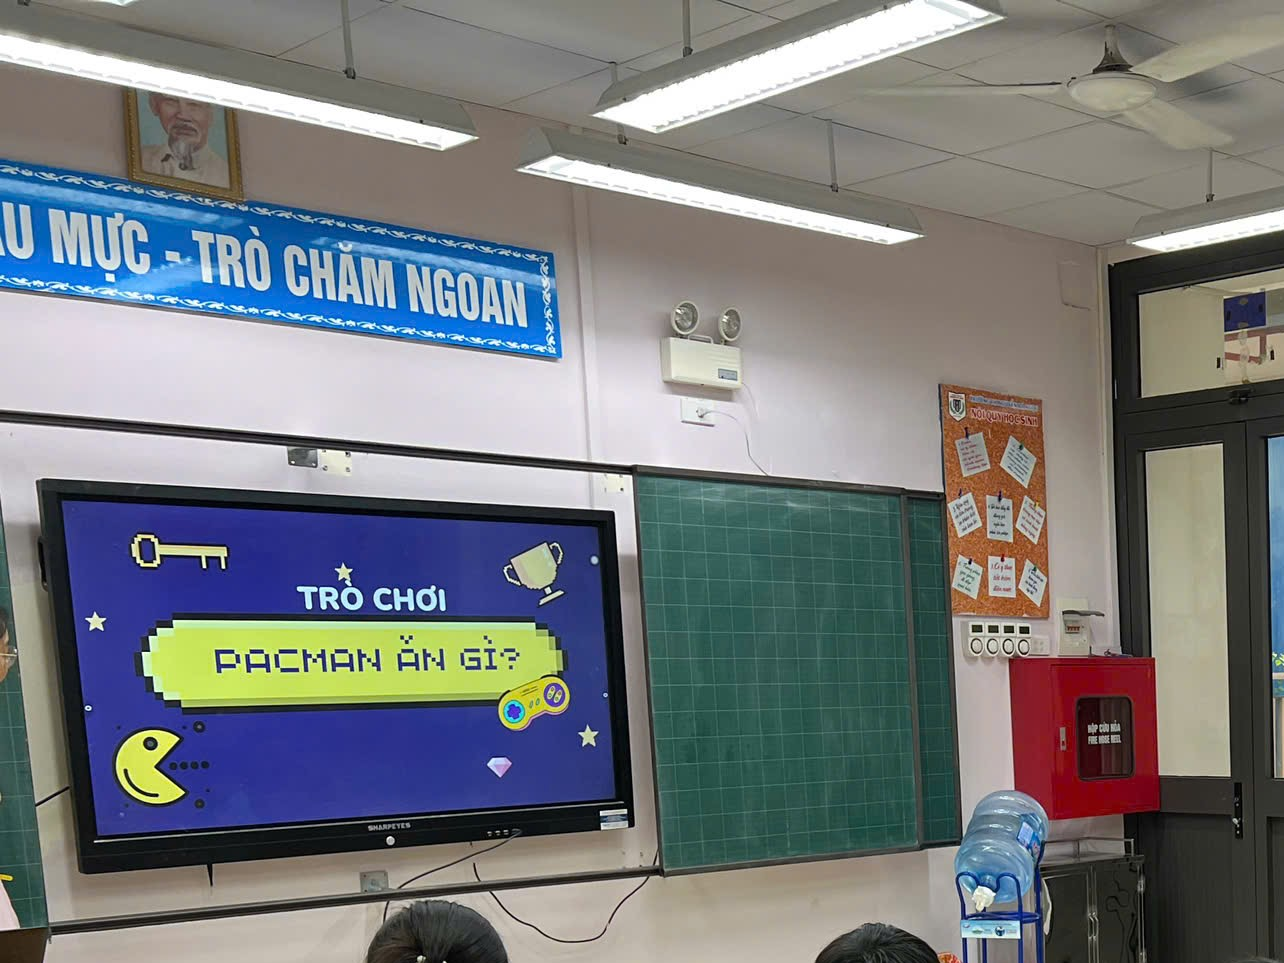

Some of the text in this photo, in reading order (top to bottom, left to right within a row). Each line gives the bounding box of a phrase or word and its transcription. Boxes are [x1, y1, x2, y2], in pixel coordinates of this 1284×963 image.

[48, 208, 151, 283] MỰC
[191, 226, 272, 292] TRÒ
[283, 240, 397, 310] CHĂM
[405, 263, 528, 328] NGOAN
[296, 579, 447, 612] TRÒ CHƠI
[214, 635, 521, 674] PACMAN ĂN GÌ?
[367, 821, 411, 832] SHARPEYES
